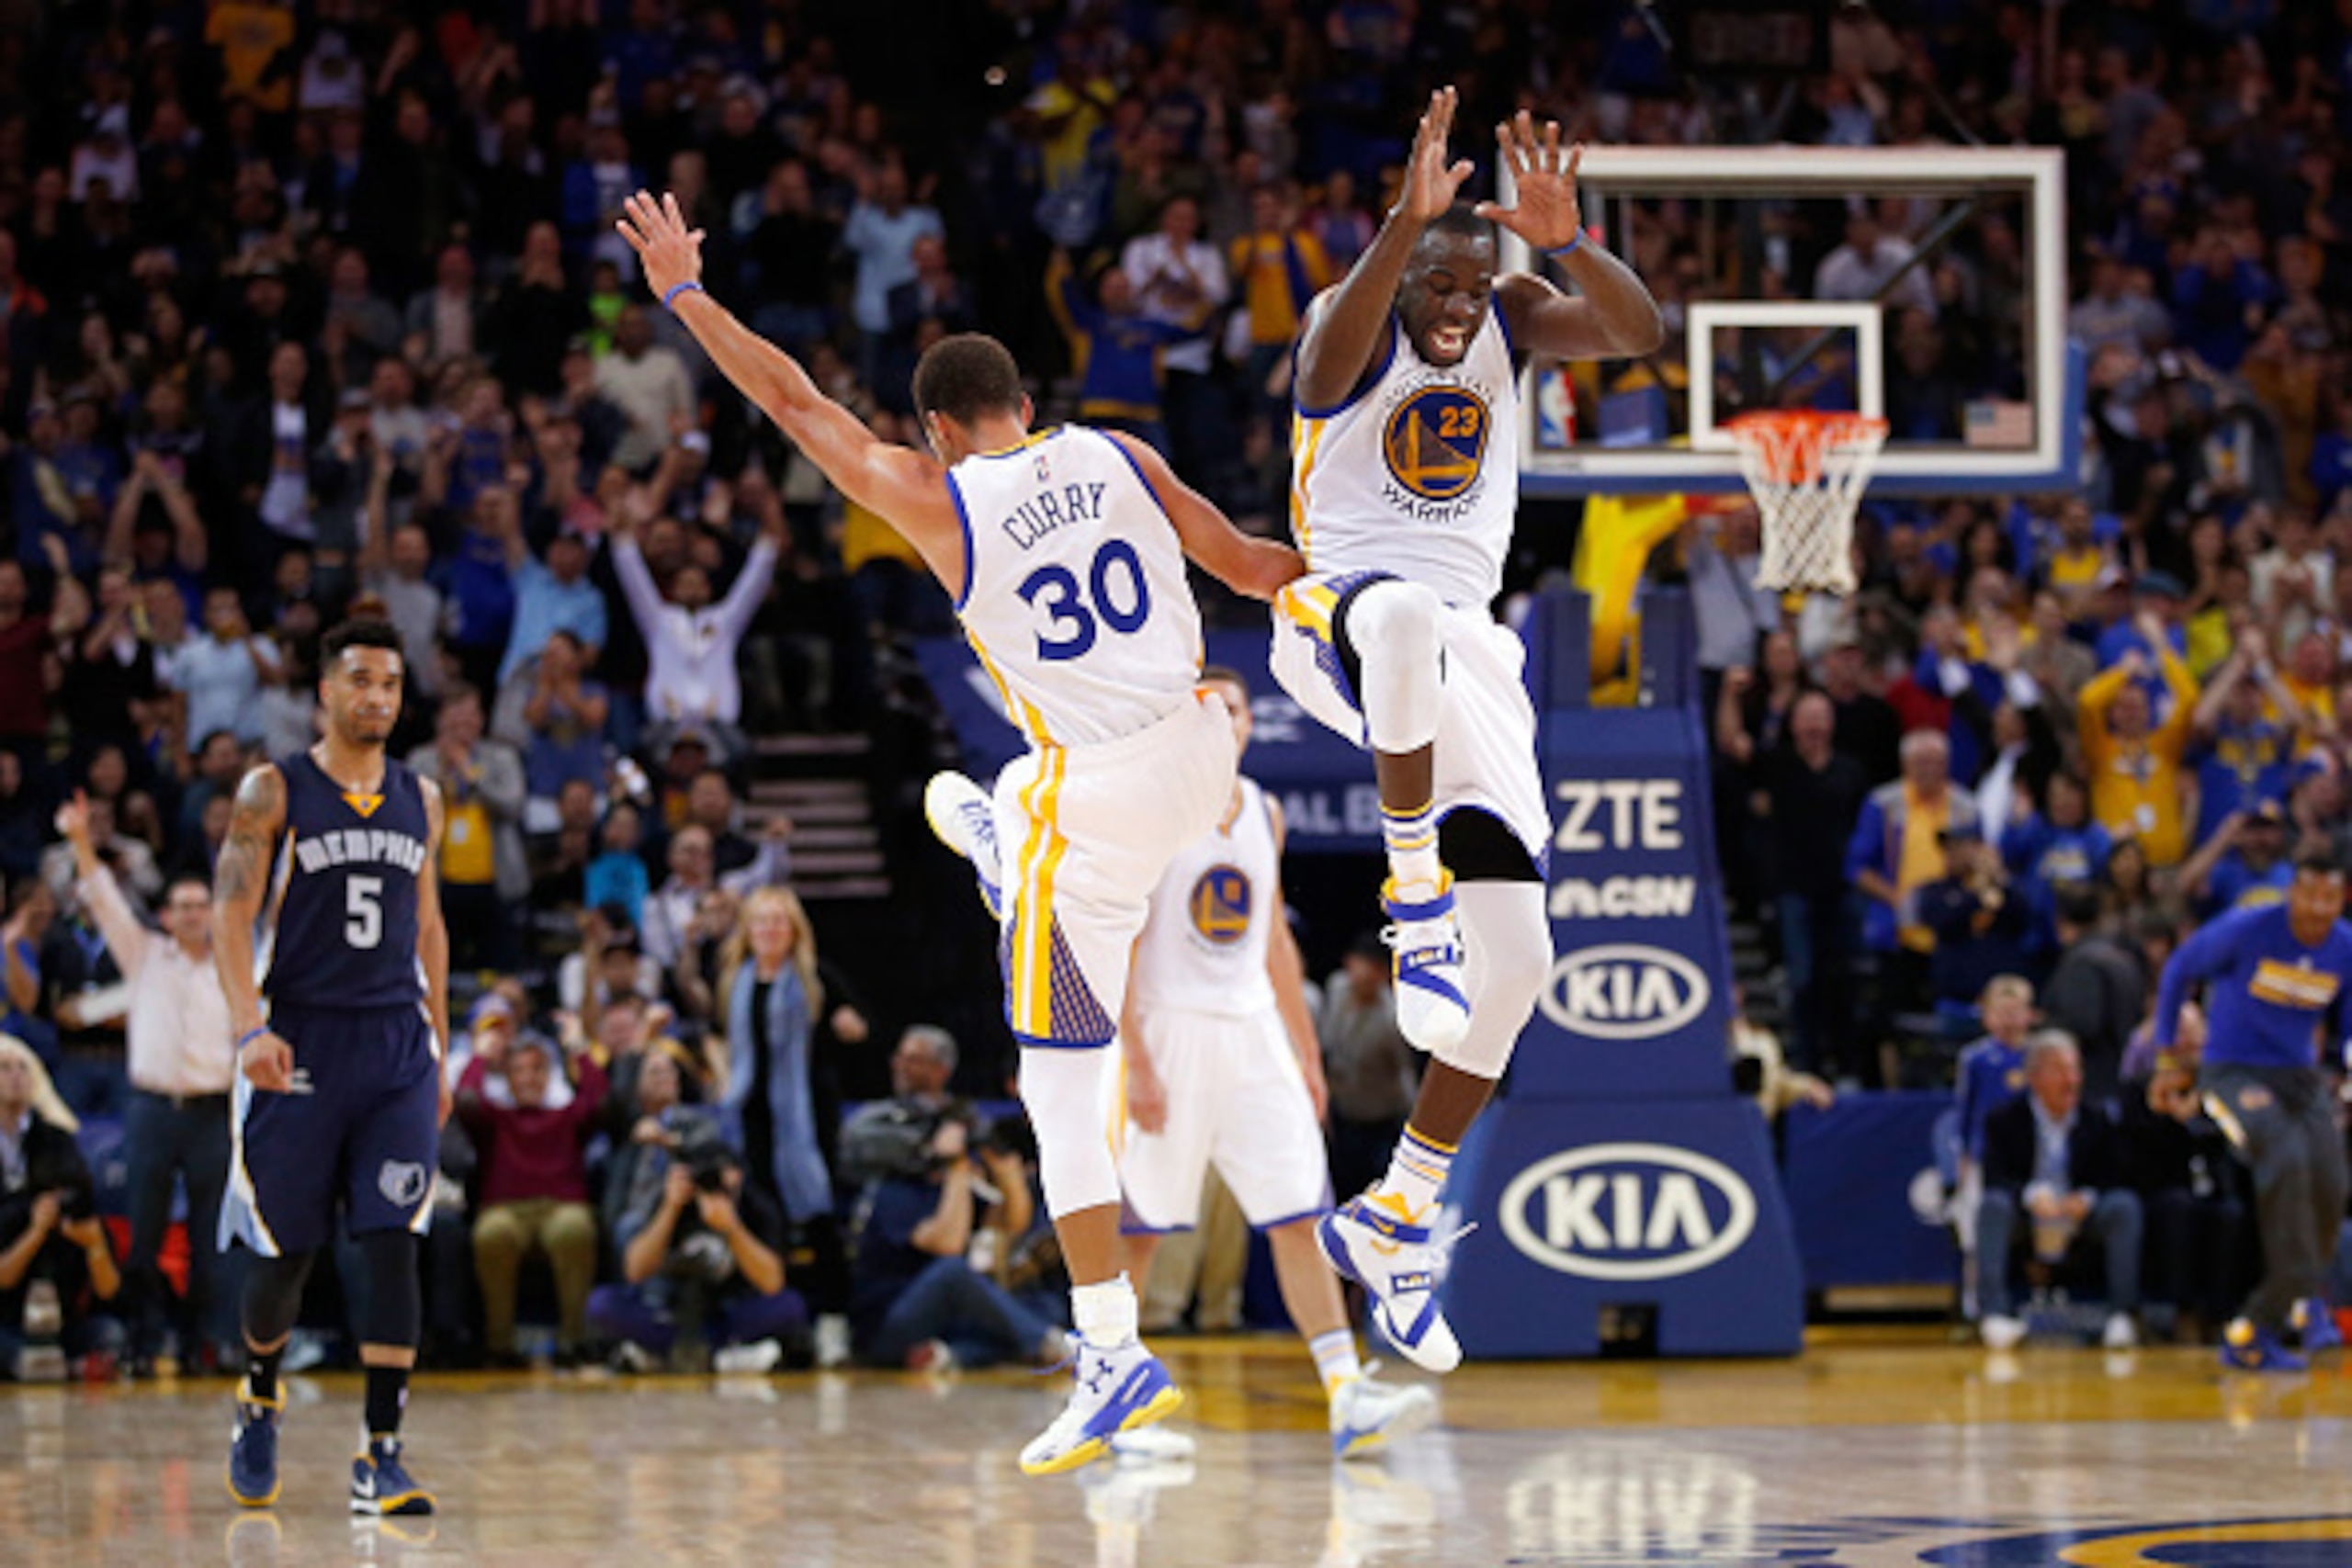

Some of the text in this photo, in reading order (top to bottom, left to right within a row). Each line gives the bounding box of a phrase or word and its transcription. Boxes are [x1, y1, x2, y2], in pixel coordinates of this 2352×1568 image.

[1440, 406, 1479, 437] 23
[1002, 483, 1105, 549] CURRY
[1015, 539, 1150, 660] 30
[1555, 780, 1682, 851] ZTE
[296, 829, 425, 875] MEMPHIS
[345, 874, 383, 950] 5
[1566, 966, 1680, 1018] KIA
[1545, 1173, 1713, 1249] KIA
